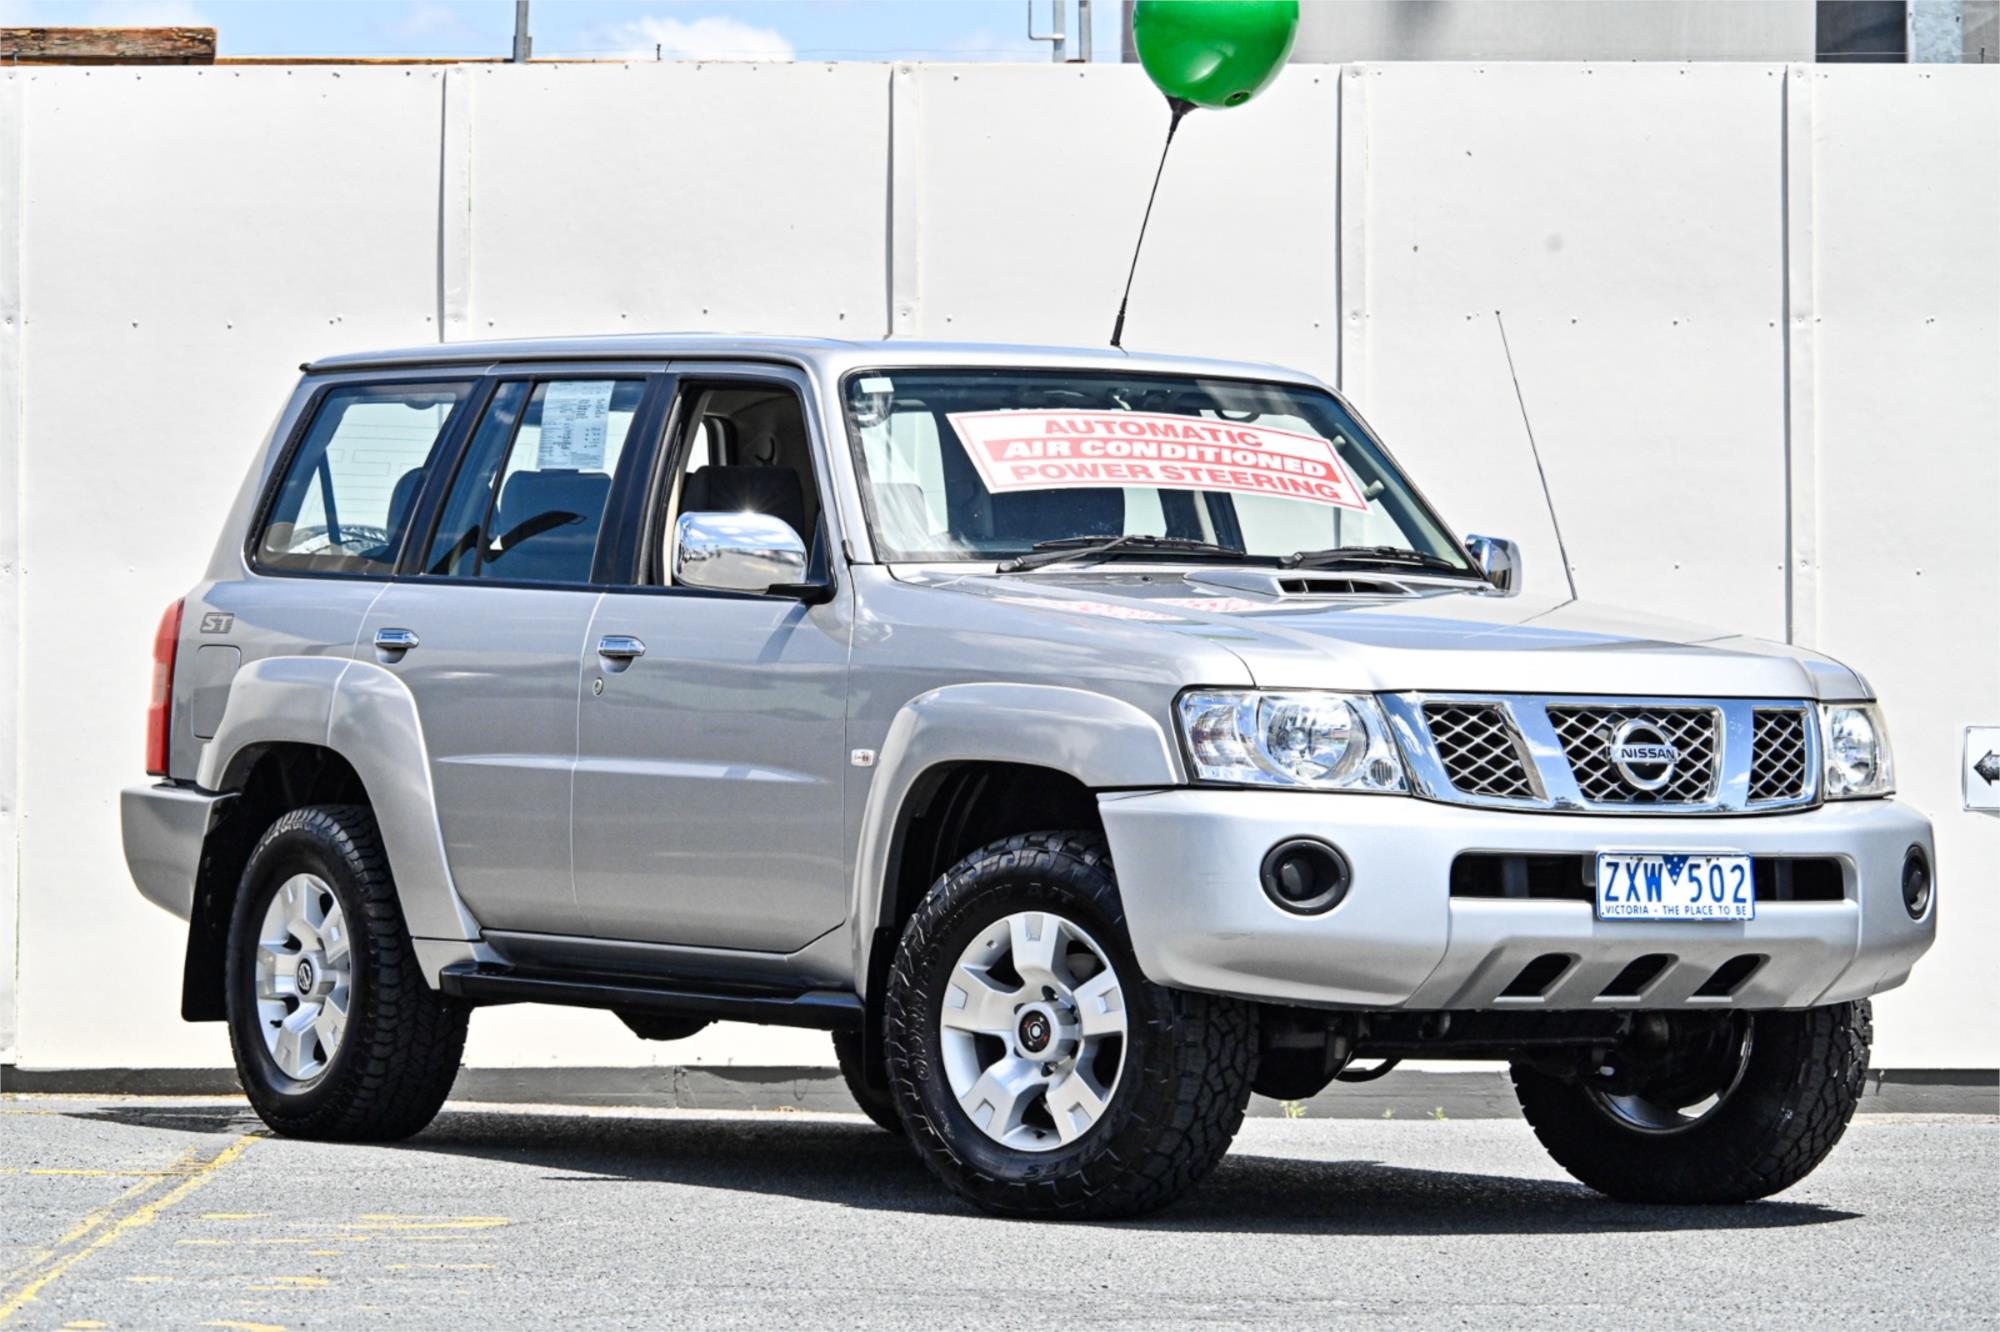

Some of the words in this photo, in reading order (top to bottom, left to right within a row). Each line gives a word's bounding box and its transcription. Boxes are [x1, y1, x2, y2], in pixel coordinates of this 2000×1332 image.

[1045, 419, 1263, 448] AUTOMATIC
[1003, 440, 1072, 460] AIR
[1084, 440, 1326, 477] CONDITIONED
[1011, 463, 1153, 482] POWER
[1163, 465, 1341, 500] STEERING
[201, 612, 234, 634] ST
[1621, 748, 1675, 759] NISSAN
[1604, 861, 1663, 903] ZXW
[1687, 863, 1747, 904] 502
[1605, 905, 1649, 915] VICTORIA
[1662, 905, 1680, 915] THE
[1684, 905, 1713, 916] PLACE
[1718, 906, 1731, 916] TO
[1735, 906, 1747, 916] BE
